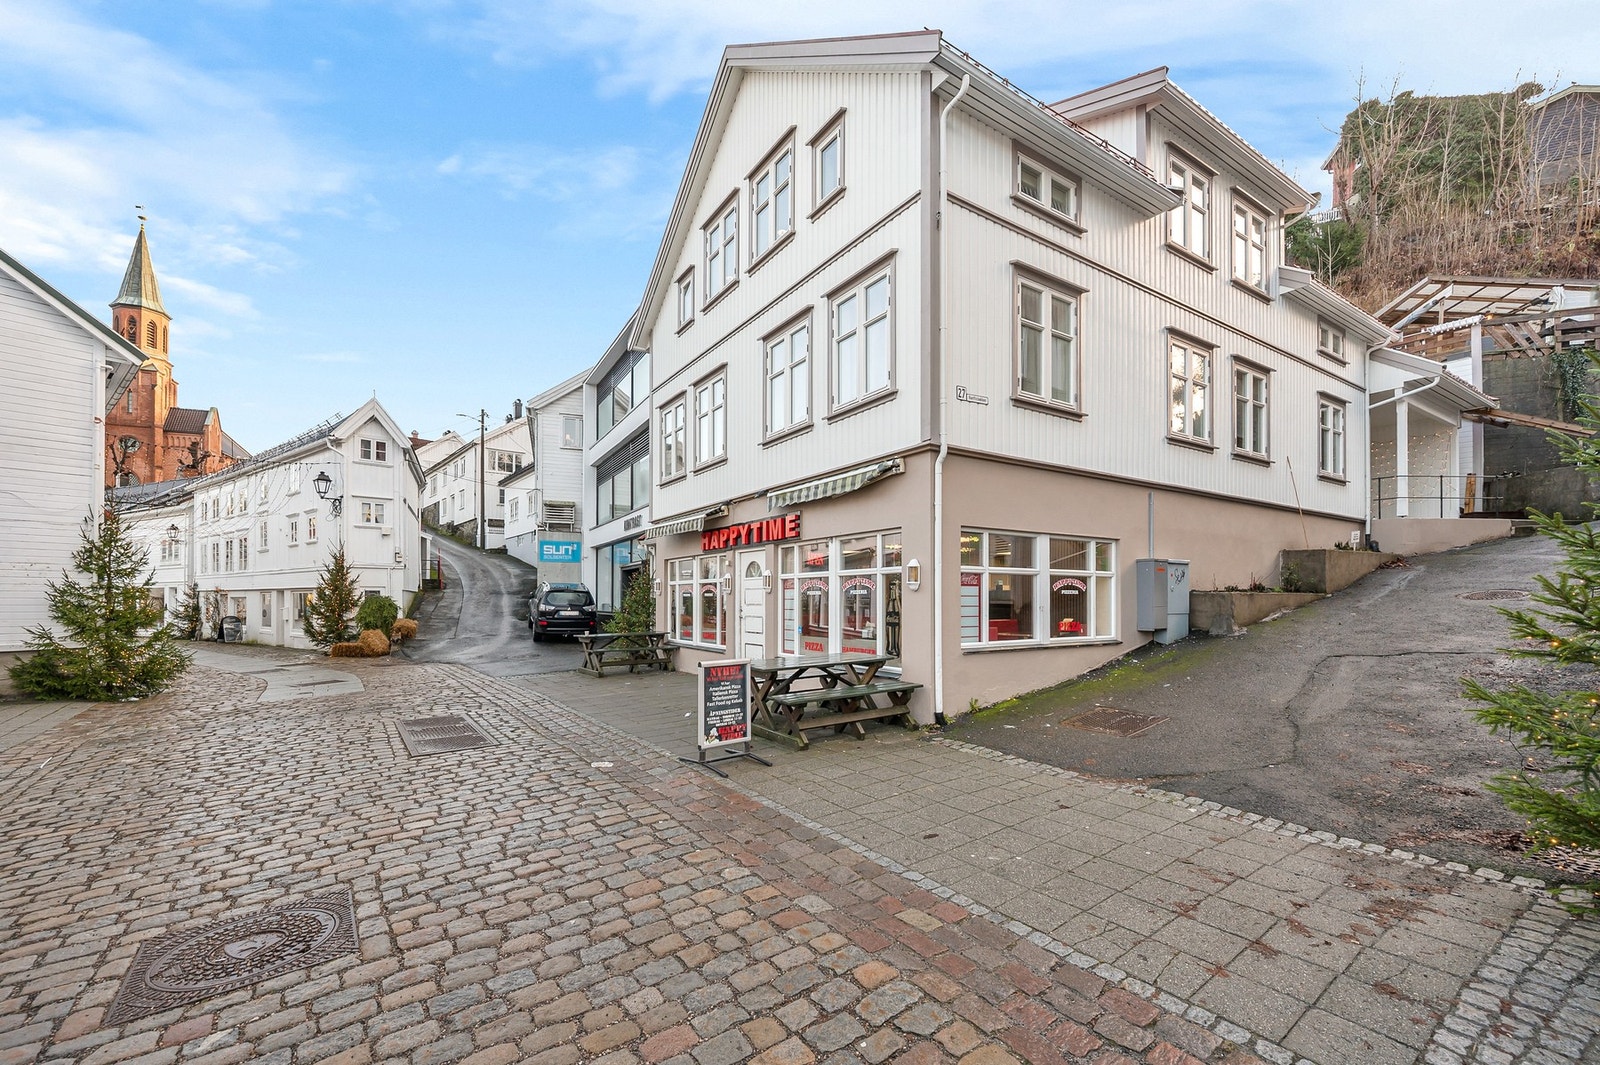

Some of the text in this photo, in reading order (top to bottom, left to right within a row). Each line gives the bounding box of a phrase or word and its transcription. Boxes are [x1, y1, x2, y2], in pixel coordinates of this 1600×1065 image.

[958, 388, 966, 398] 27
[701, 514, 800, 550] HAPPYTIME
[804, 641, 824, 652] PIZZA
[710, 666, 741, 676] NYHET
[718, 724, 746, 734] HAPPY
